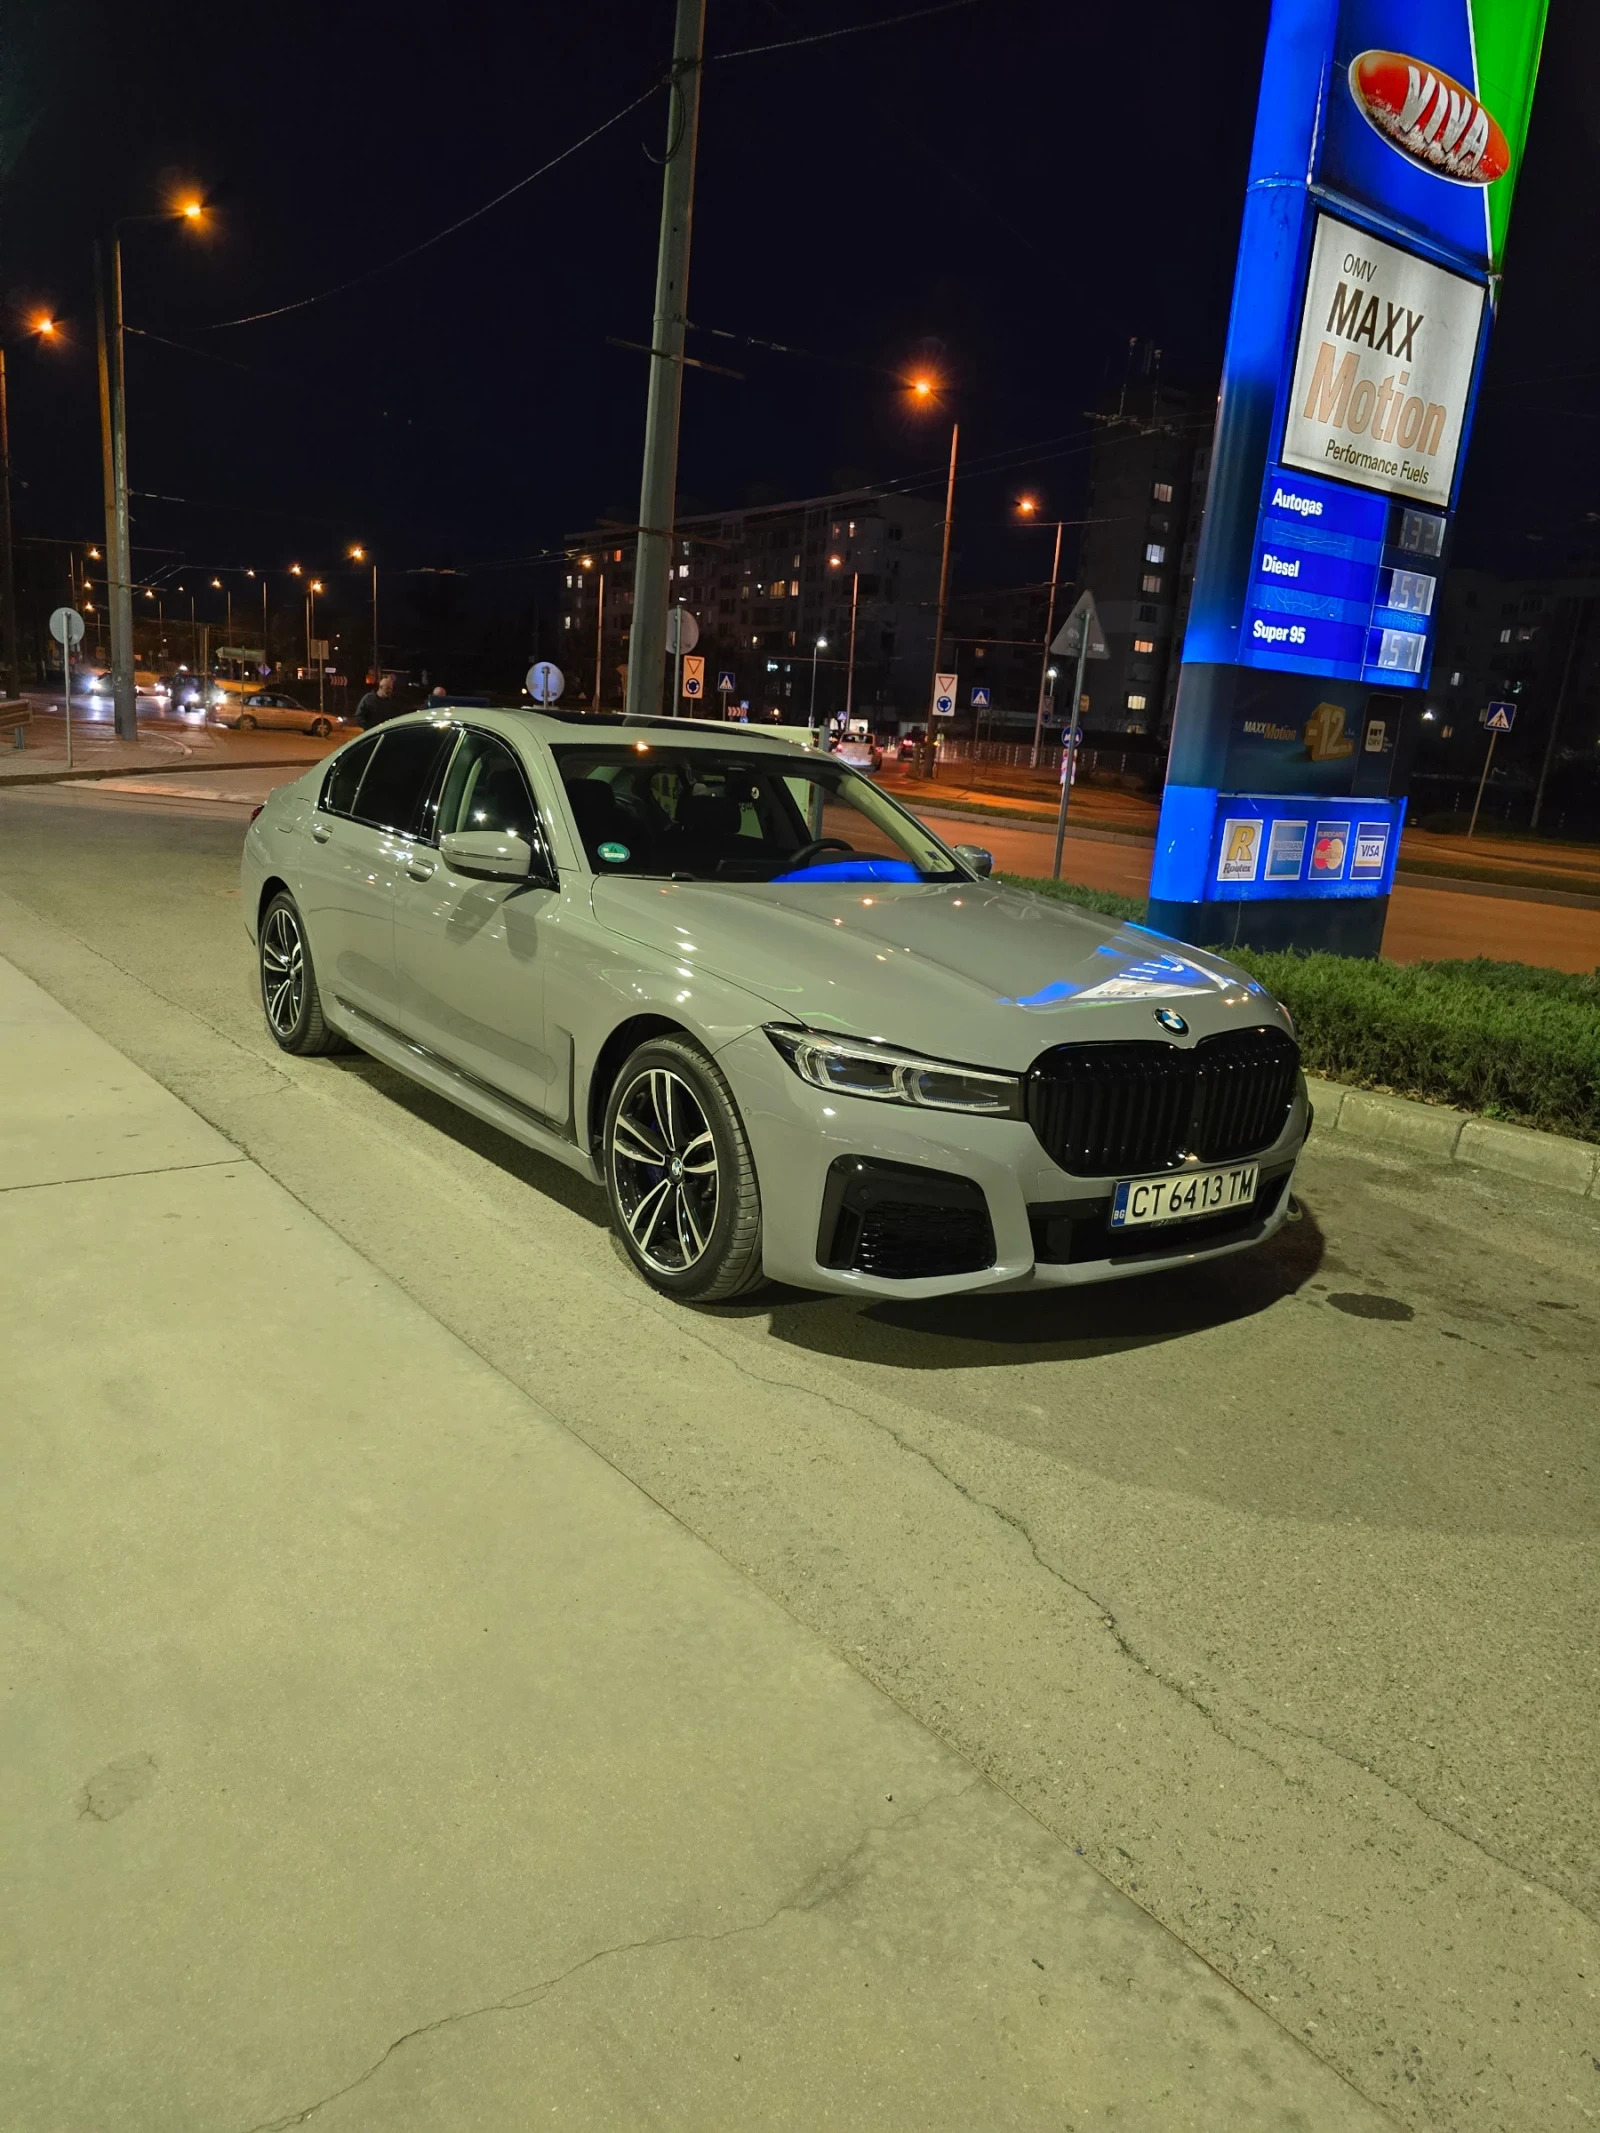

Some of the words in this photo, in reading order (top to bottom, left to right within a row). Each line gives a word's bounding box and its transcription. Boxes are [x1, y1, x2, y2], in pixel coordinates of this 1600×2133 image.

[1399, 65, 1489, 174] VIVA
[1343, 253, 1377, 283] OMV
[1325, 281, 1425, 363] MAXX
[1303, 341, 1447, 456] Motion
[1324, 438, 1398, 476] Performance
[1399, 460, 1430, 484] Fuels
[1271, 487, 1323, 517] Autogas
[1261, 553, 1300, 578] Diesel
[1252, 619, 1289, 643] Super
[1289, 625, 1306, 644] 95
[1361, 844, 1380, 857] VISA
[1223, 862, 1252, 874] Routex
[1131, 1183, 1166, 1217] CT
[1169, 1174, 1223, 1212] 6413
[1229, 1168, 1254, 1202] TM
[1113, 1209, 1126, 1220] BG
